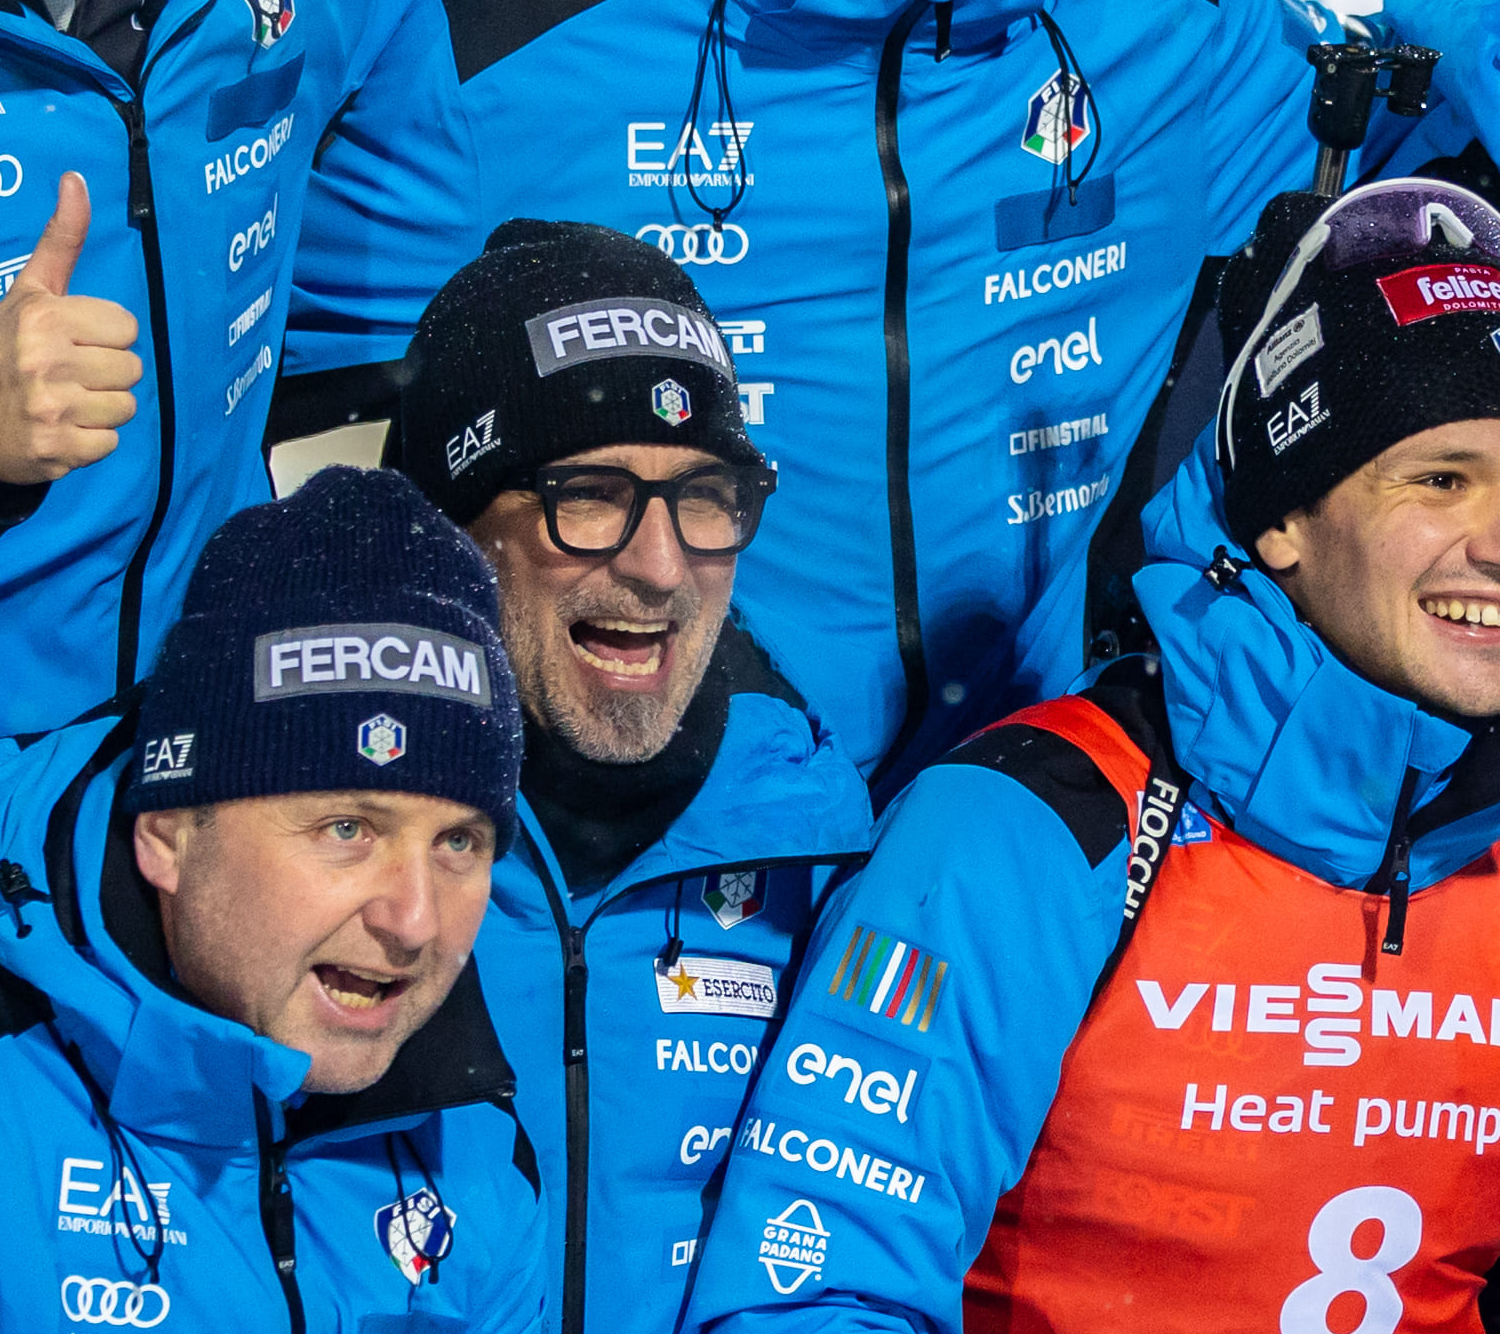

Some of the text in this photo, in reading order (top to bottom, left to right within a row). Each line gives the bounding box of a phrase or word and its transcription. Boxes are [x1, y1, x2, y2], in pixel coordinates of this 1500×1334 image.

[205, 113, 294, 194] FALCONERI
[626, 122, 754, 172] EA7
[628, 172, 755, 188] EMPORIO ARMANI
[228, 193, 278, 273] enel
[985, 242, 1126, 305] FALCONERI
[1454, 267, 1491, 275] PASTA
[546, 308, 727, 367] FERCAM
[1010, 316, 1102, 384] enel
[1267, 328, 1293, 354] Allianz
[1274, 339, 1301, 363] Agenzia
[446, 409, 496, 467] EA7
[1028, 413, 1108, 450] FINSTRAL
[1267, 381, 1319, 447] EA7
[271, 637, 480, 697] FERCAM
[144, 734, 194, 774] EA7
[1124, 778, 1178, 919] FIOCCHI
[703, 980, 774, 1005] ESERCITO
[787, 1043, 917, 1124] enel
[1180, 1083, 1334, 1134] Heat
[740, 1117, 925, 1204] FALCONERI
[760, 1241, 826, 1265] PADANO
[763, 1226, 827, 1251] GRANA
